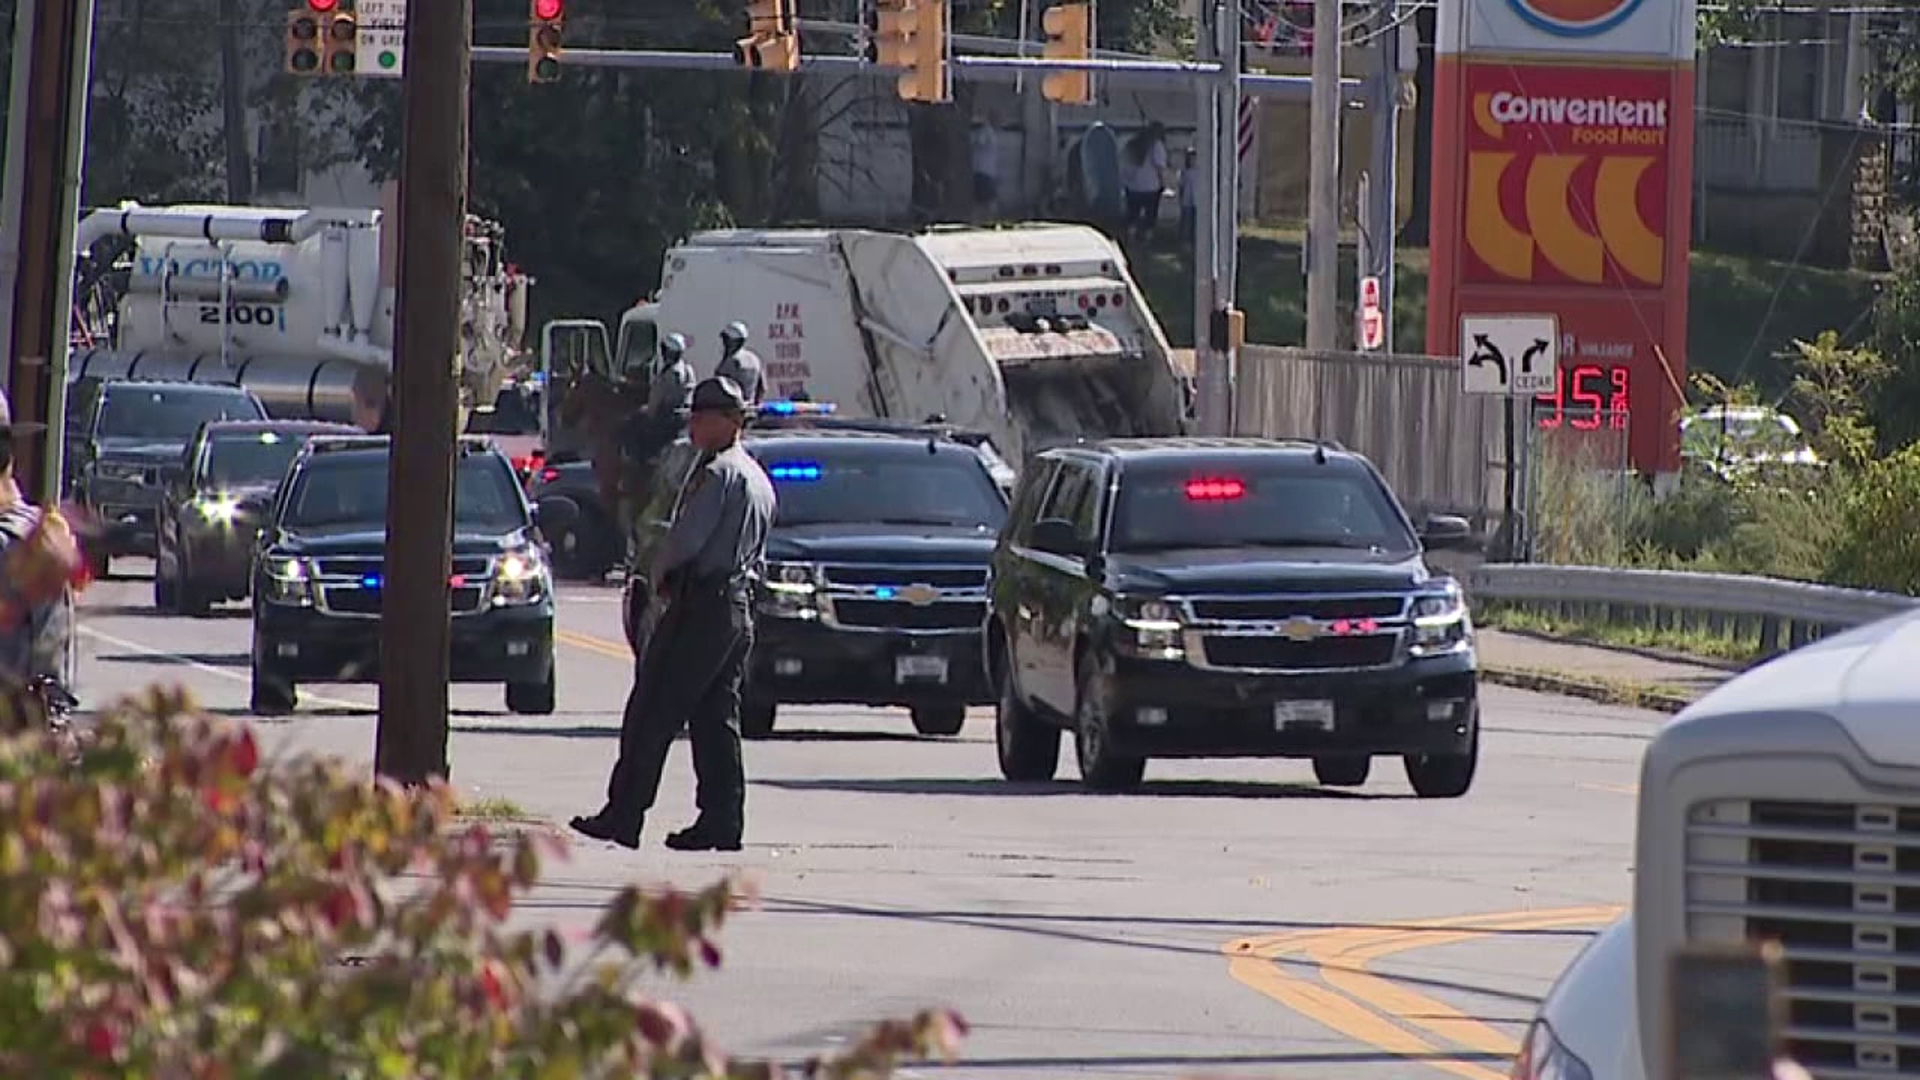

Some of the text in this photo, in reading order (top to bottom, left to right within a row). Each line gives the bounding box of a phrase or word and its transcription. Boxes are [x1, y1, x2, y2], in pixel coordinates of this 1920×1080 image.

[1491, 91, 1667, 126] Convenient
[1572, 127, 1664, 144] Food Mart
